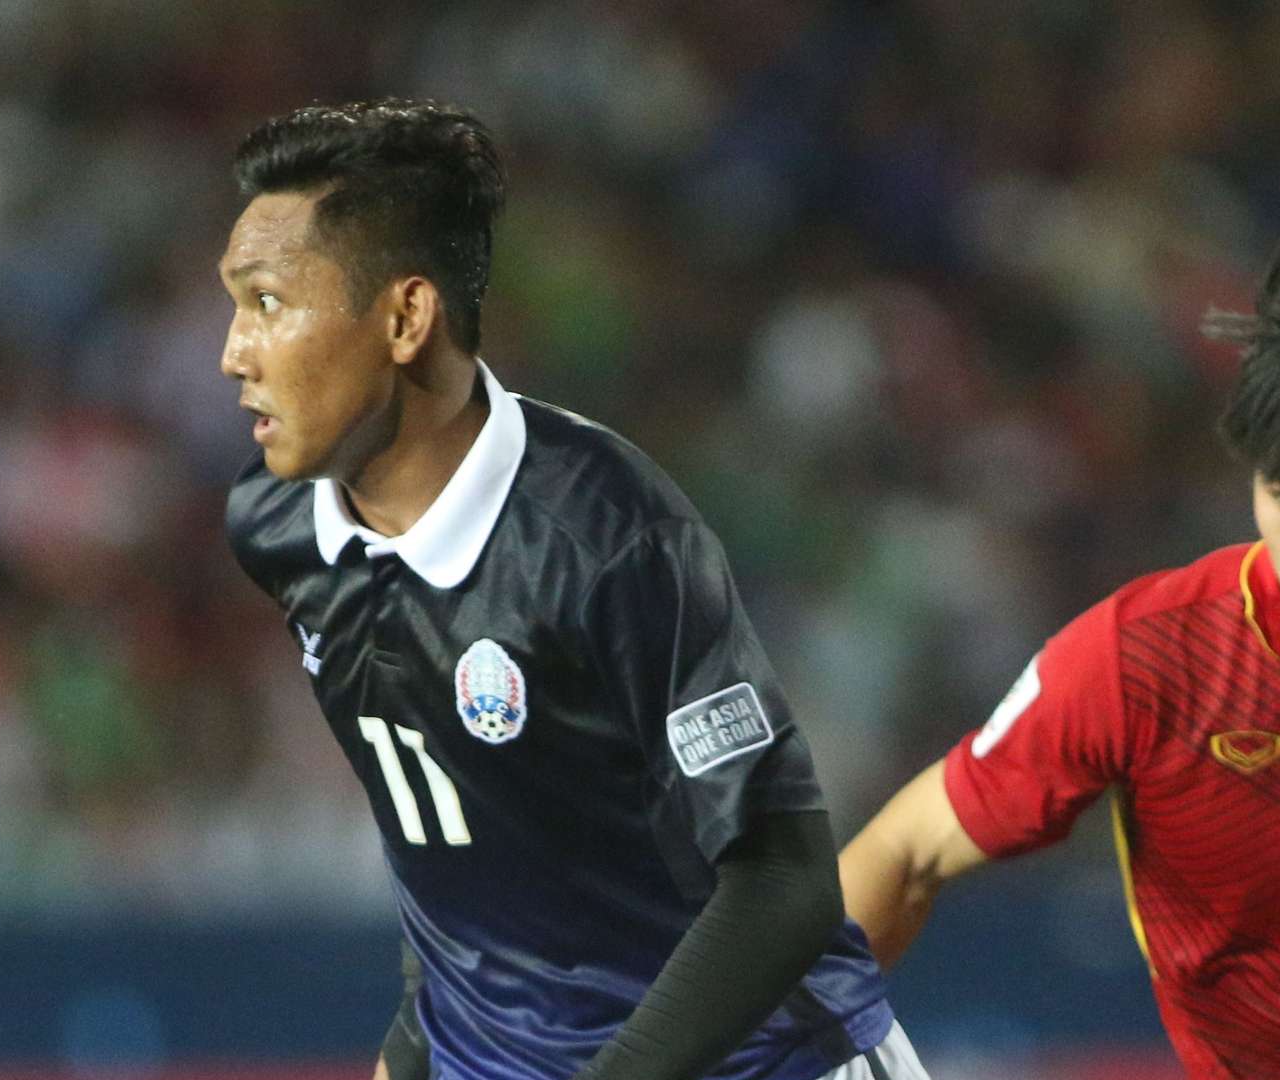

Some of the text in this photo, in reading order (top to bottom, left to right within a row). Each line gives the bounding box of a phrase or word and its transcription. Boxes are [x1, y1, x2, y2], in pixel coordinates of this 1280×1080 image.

[673, 698, 751, 745] ONE ASIA
[683, 717, 762, 763] ONE GOAL
[358, 716, 472, 846] 11
